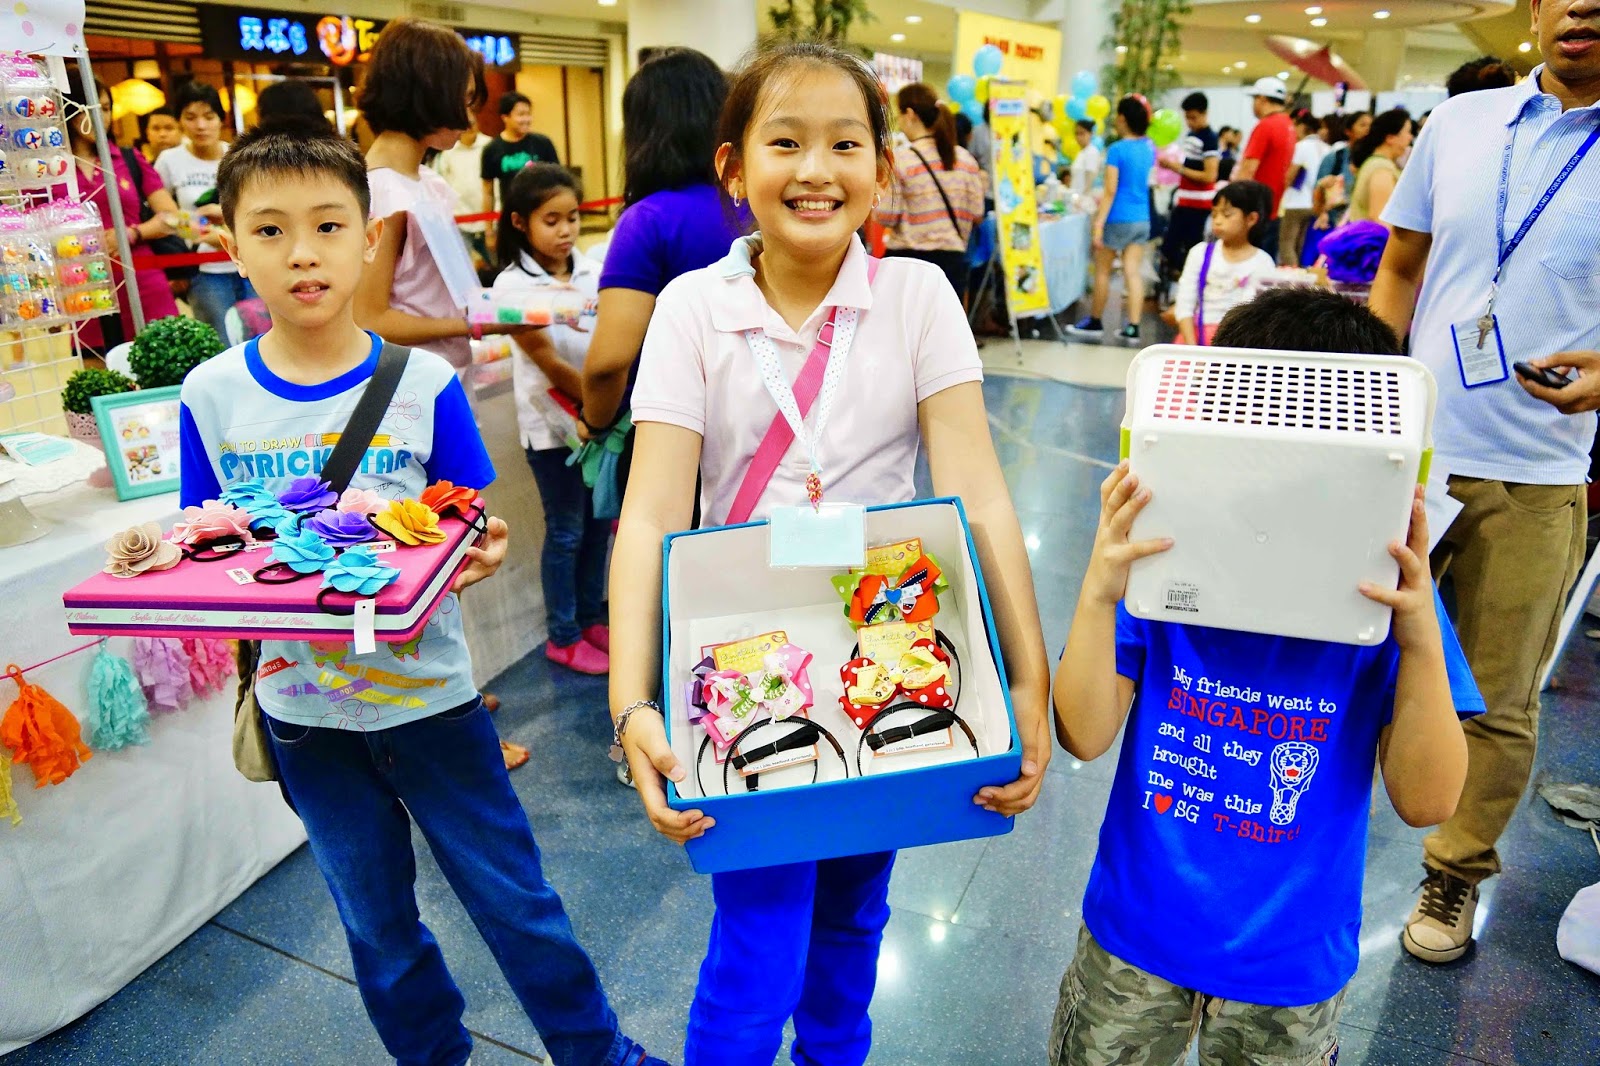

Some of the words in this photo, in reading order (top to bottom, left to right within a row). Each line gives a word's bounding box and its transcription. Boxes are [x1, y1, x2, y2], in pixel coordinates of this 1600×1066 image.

[1513, 211, 1538, 244] ROBINSONS
[1536, 194, 1550, 212] LAND
[1548, 153, 1581, 195] CORPORATION
[219, 447, 332, 480] PTRICK
[360, 448, 412, 475] TAR
[240, 440, 256, 452] TO
[262, 437, 301, 451] DRAW
[1173, 665, 1192, 691] My
[1196, 677, 1261, 703] friends
[1267, 693, 1313, 714] went
[1318, 698, 1337, 714] to
[1167, 687, 1331, 742] SINGAPORE
[1153, 745, 1217, 780] brought
[1158, 721, 1185, 742] and
[1193, 733, 1211, 753] all
[1223, 740, 1263, 766] they
[1141, 790, 1152, 810] I
[1174, 800, 1200, 823] SG
[1148, 769, 1174, 790] me
[1182, 781, 1214, 803] was
[1224, 793, 1262, 815] this
